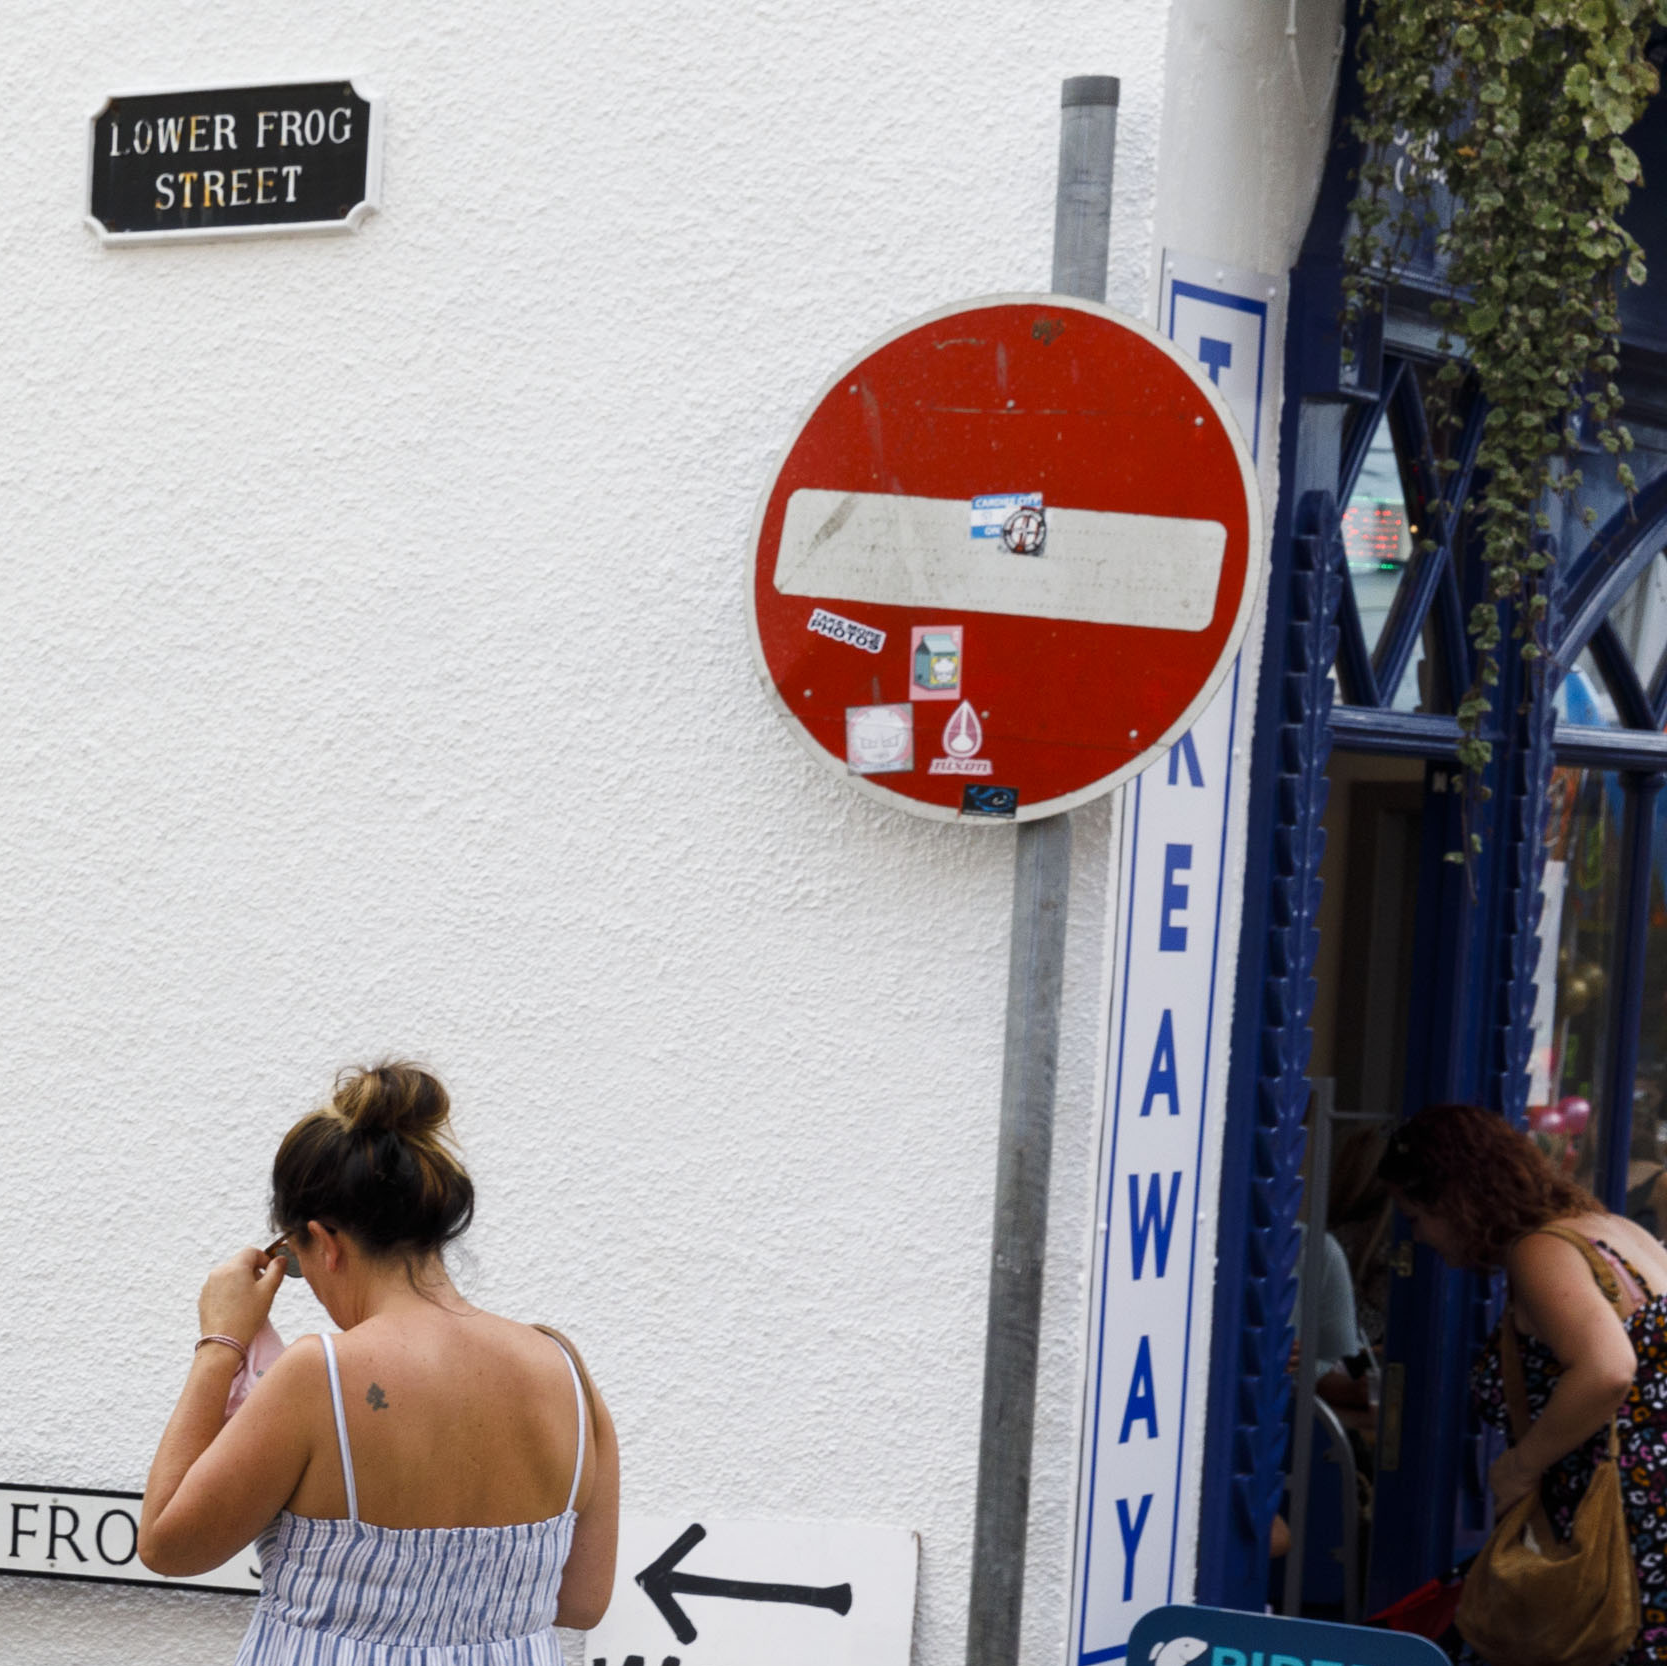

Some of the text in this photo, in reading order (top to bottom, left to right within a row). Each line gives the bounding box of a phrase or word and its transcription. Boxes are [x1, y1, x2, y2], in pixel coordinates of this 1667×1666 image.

[110, 107, 353, 157] LOWER FROG
[155, 165, 303, 210] STREET
[810, 619, 880, 651] PHOTOS
[1114, 335, 1233, 1602] TEAWAY
[8, 1501, 138, 1566] FRO
